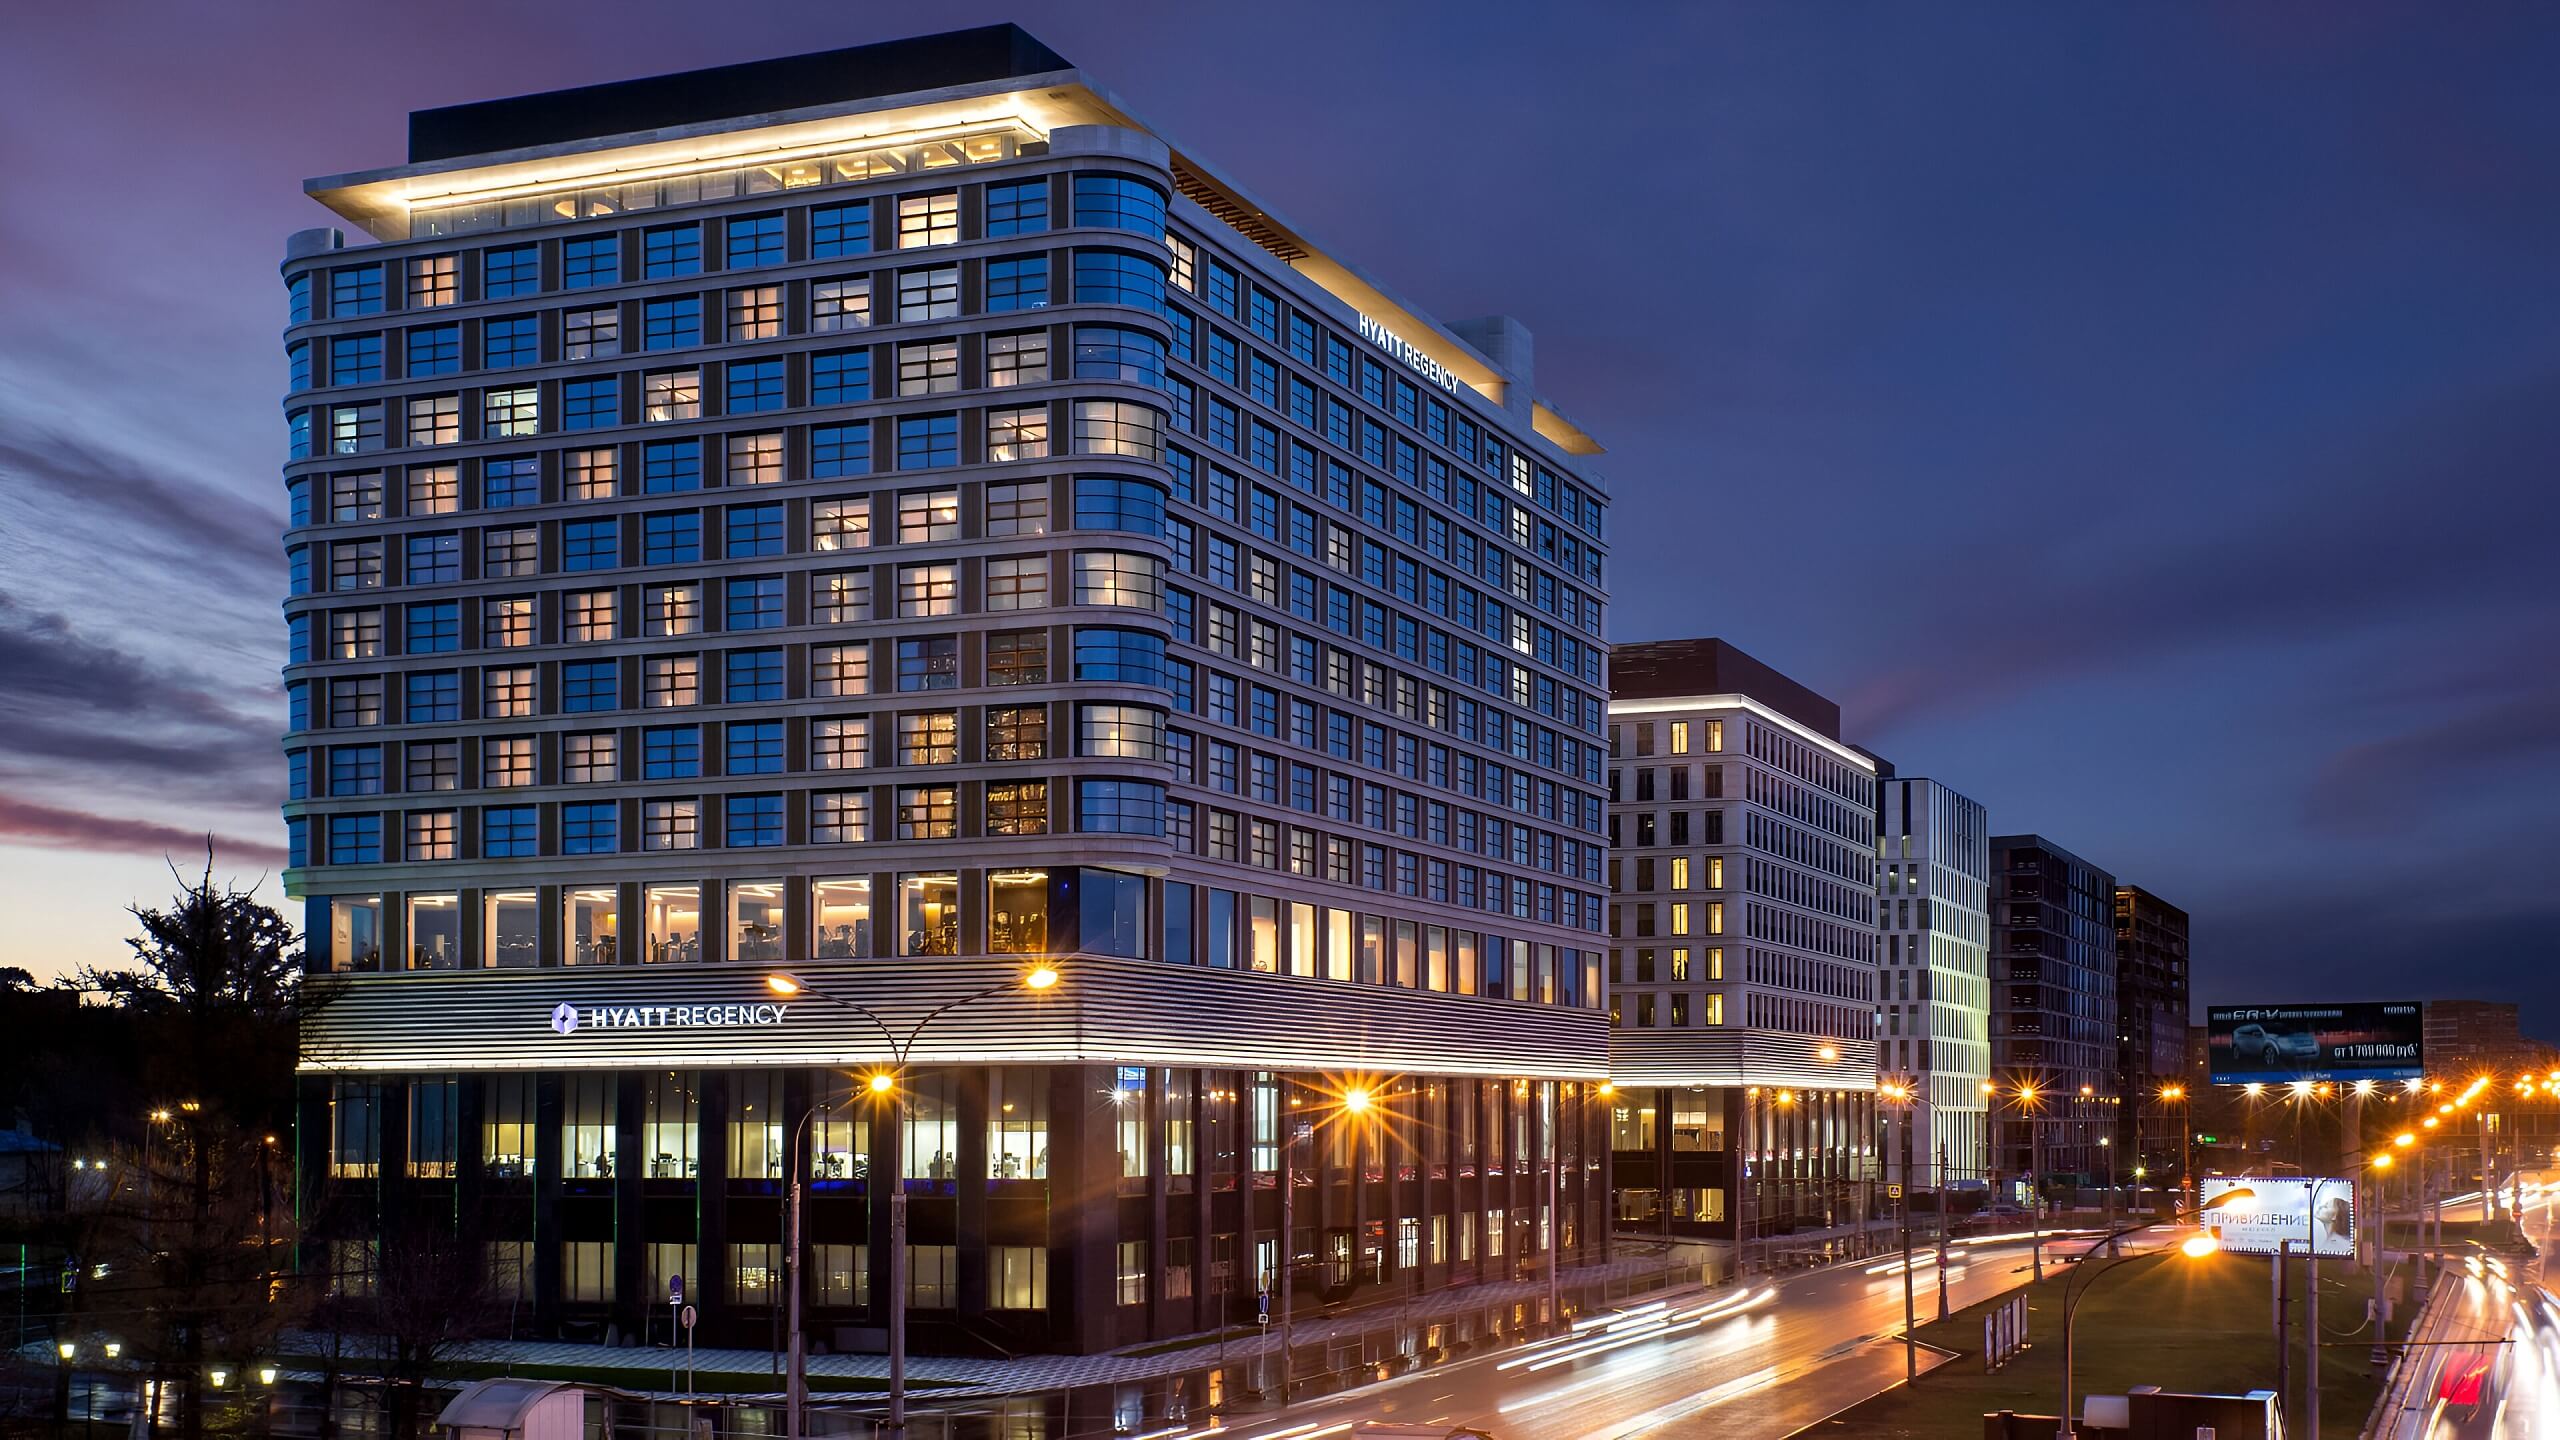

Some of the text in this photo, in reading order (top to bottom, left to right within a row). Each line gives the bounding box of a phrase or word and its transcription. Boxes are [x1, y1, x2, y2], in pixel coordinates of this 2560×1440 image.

[1359, 311, 1459, 394] HYATT REGENCY
[591, 1005, 787, 1027] HYATT REGENCY
[2210, 1212, 2309, 1226] ПРИВИДЕНИЕ
